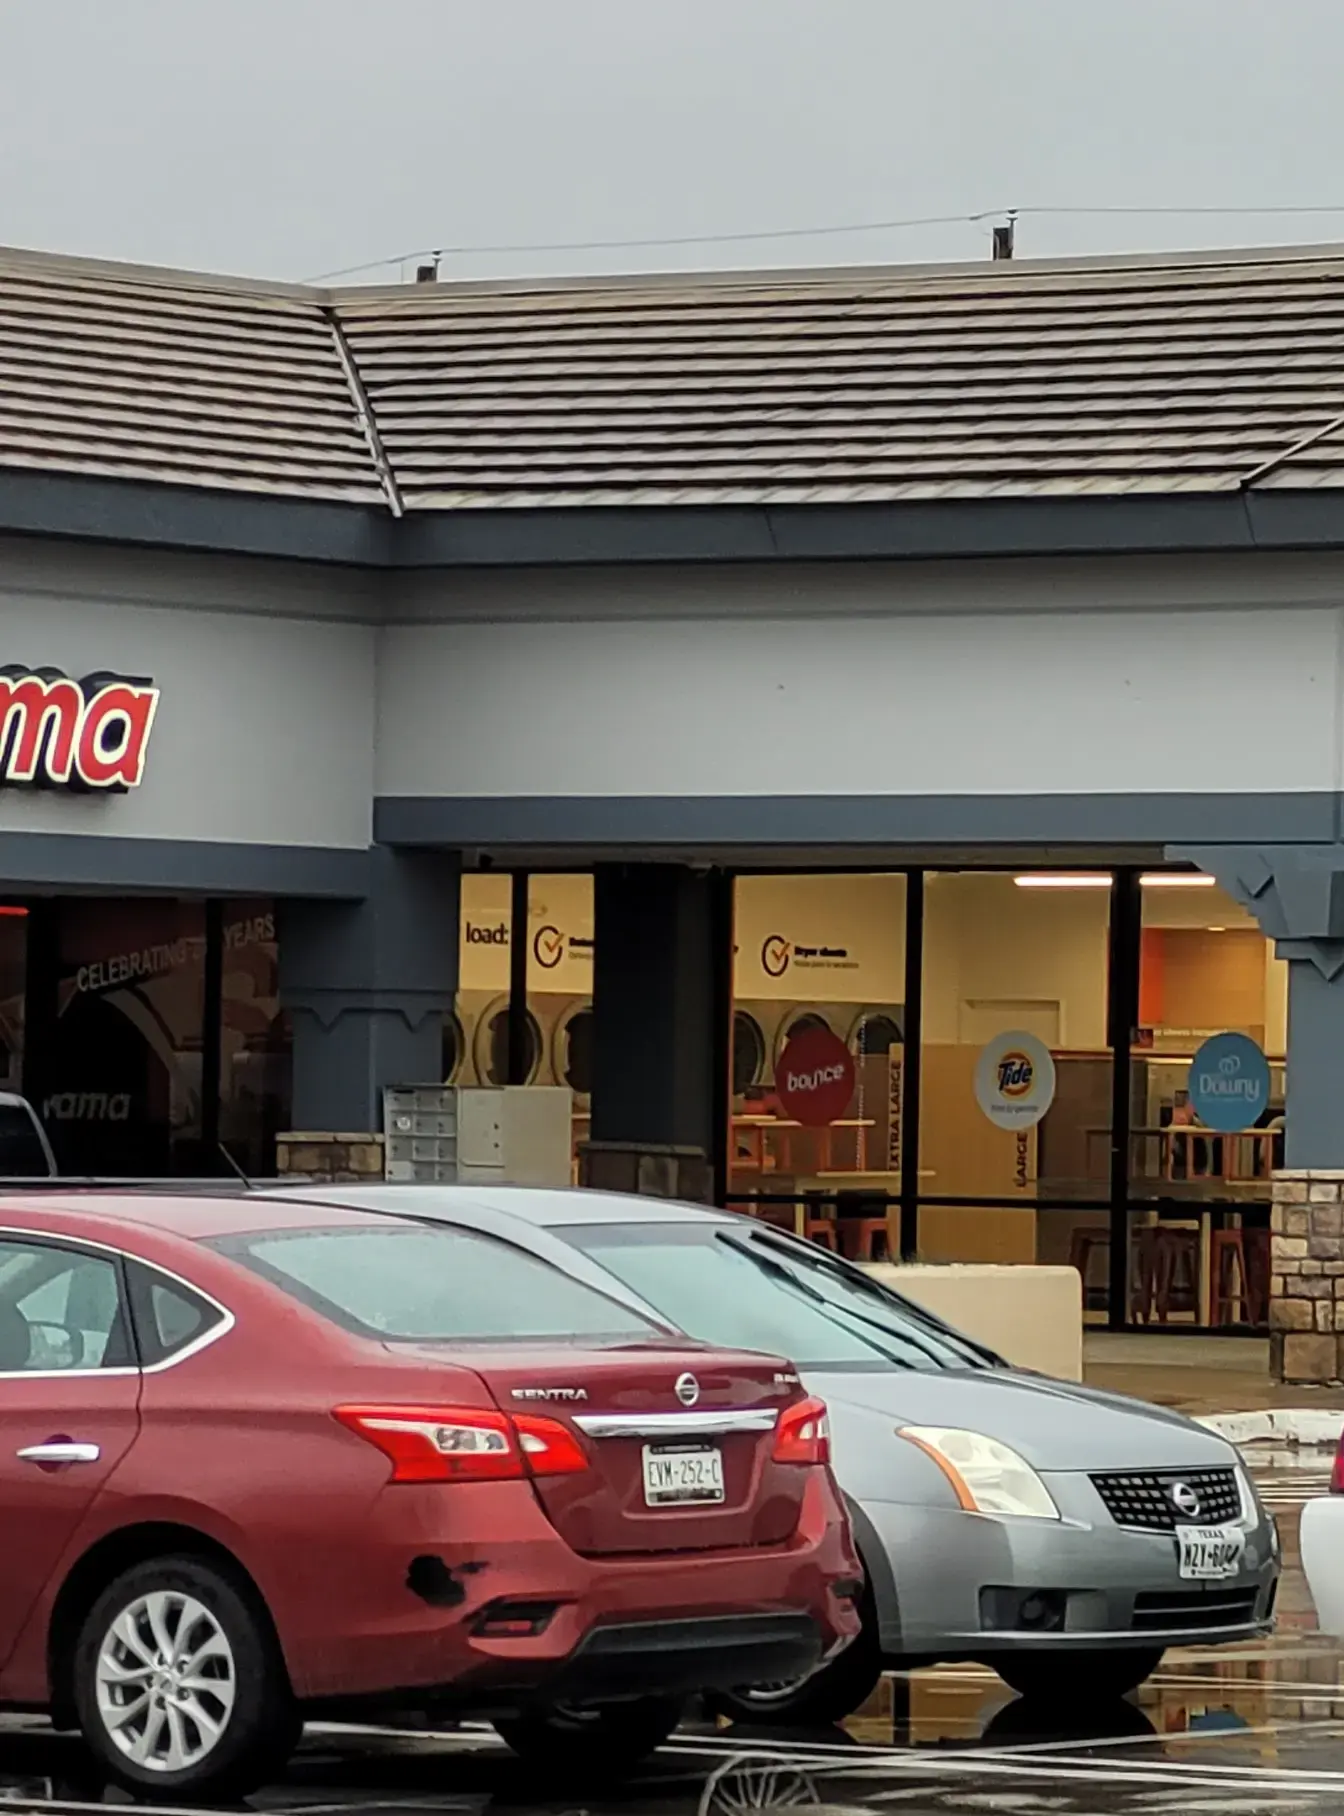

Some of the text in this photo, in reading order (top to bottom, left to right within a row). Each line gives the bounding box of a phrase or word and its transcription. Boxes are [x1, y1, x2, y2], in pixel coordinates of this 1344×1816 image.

[223, 913, 276, 950] YEARS
[466, 921, 509, 945] load:
[77, 942, 186, 993] CELEBRATING
[787, 1064, 844, 1092] bounce
[998, 1060, 1033, 1092] Tide
[1199, 1073, 1261, 1103] Downy
[1015, 1131, 1028, 1188] LARGE
[511, 1388, 589, 1401] SENTRA
[648, 1458, 720, 1488] EVM-252-C
